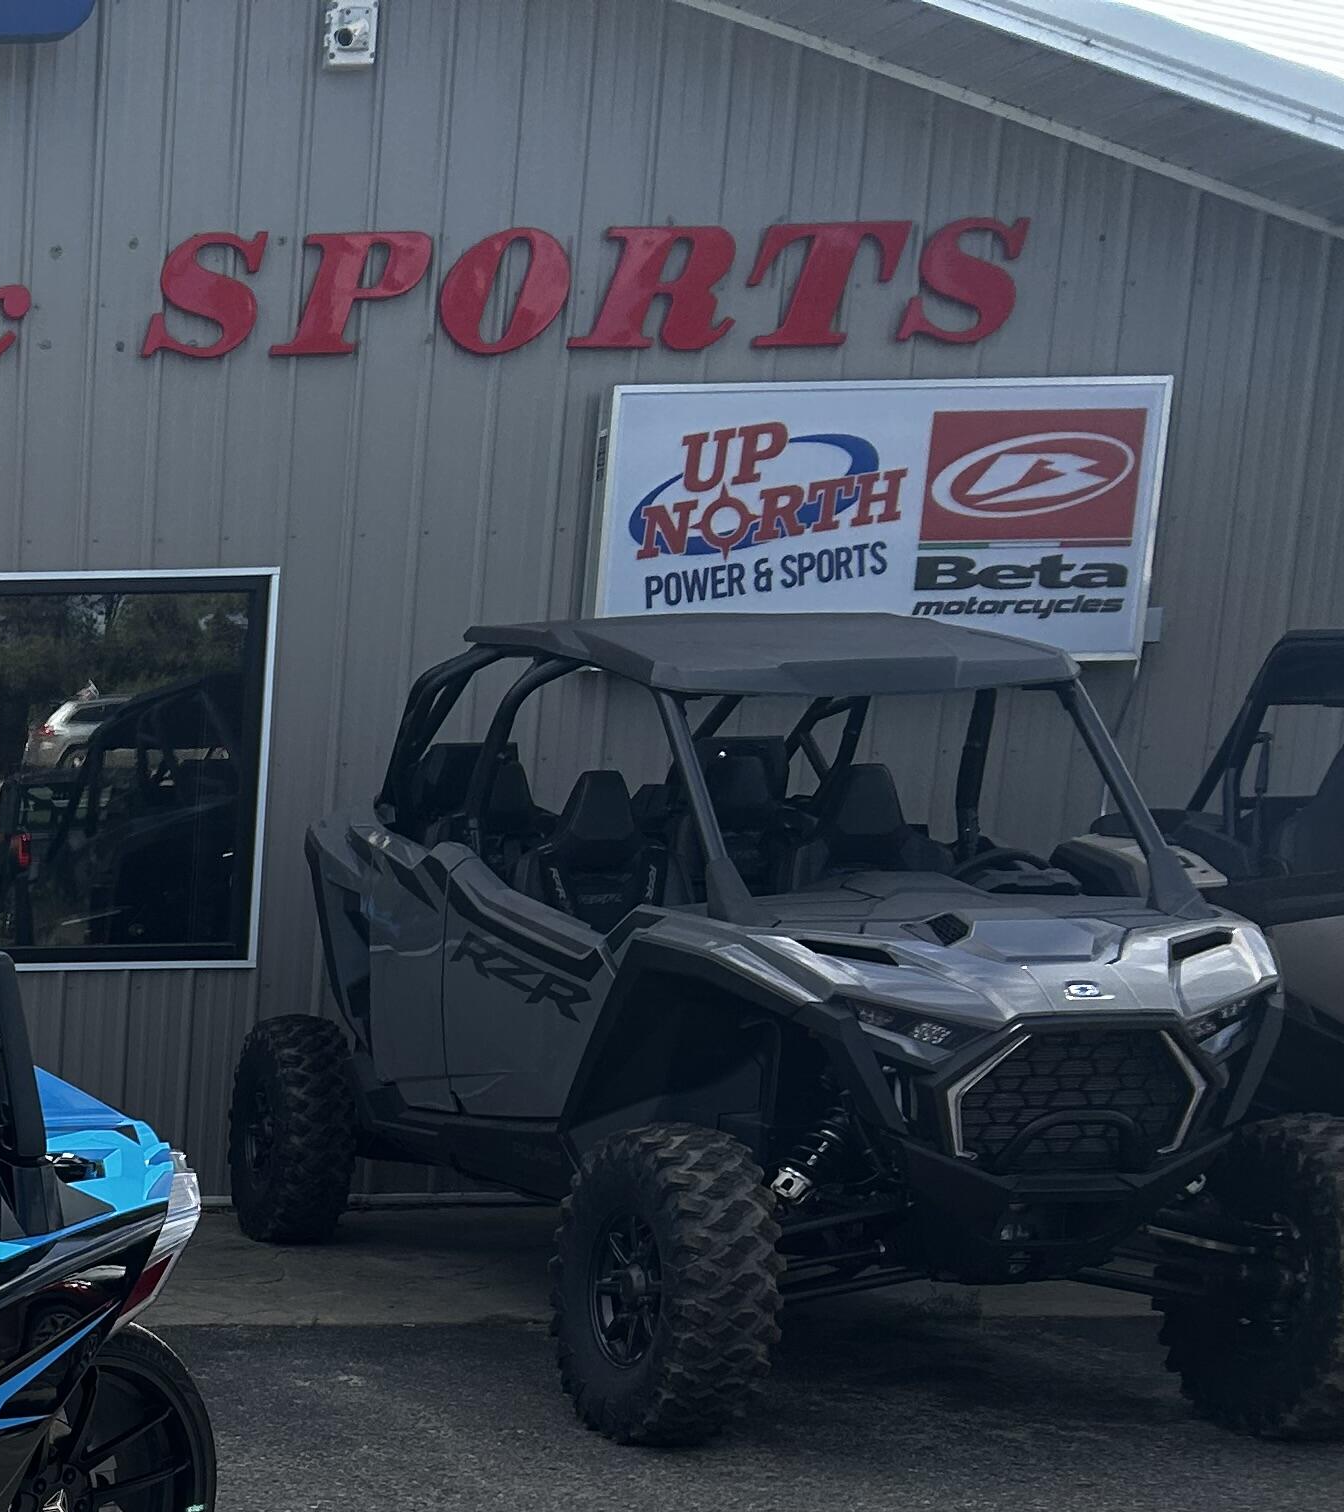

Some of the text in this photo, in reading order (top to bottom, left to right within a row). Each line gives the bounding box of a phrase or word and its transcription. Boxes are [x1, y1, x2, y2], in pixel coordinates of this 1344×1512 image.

[140, 216, 1031, 360] SPORTS
[681, 421, 788, 493] UP
[636, 467, 908, 560] NORTH
[645, 541, 888, 609] POWER & SPORTS
[912, 594, 1126, 619] motorcycles
[913, 554, 1128, 591] Beta
[449, 931, 592, 1023] RZR
